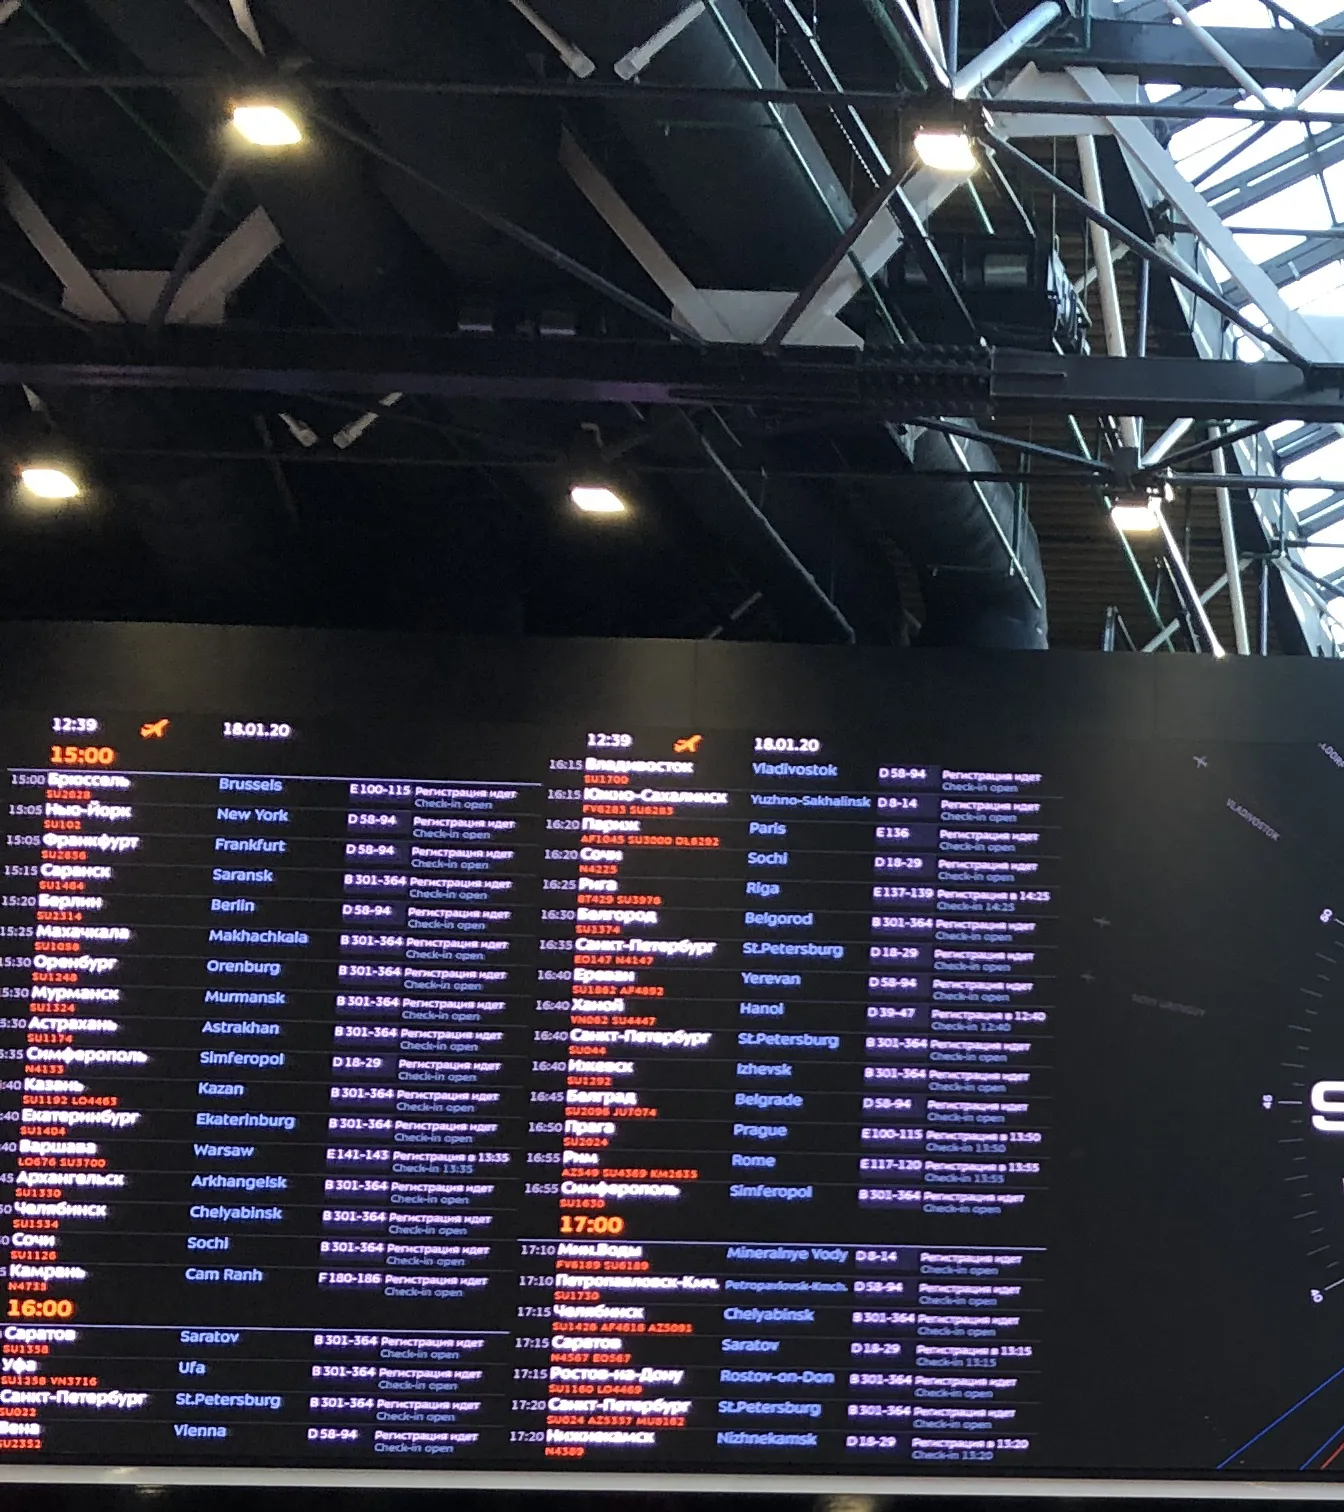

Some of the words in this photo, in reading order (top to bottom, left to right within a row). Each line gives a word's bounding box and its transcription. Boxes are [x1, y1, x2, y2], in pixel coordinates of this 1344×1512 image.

[52, 718, 97, 732] 12:39
[223, 722, 290, 737] 18.01.20
[587, 733, 632, 747] 12:39
[754, 738, 820, 752] 18.01.20
[50, 747, 113, 763] 15:00
[752, 762, 837, 777] Vladivostok
[47, 774, 130, 788] Брюссель
[219, 778, 282, 792] Brussels
[351, 784, 358, 795] E
[359, 785, 410, 796] 100-115
[751, 794, 870, 809] Yuzhno-Sakhalinsk
[217, 808, 248, 822] New
[251, 808, 289, 822] York
[348, 814, 356, 825] D
[359, 814, 397, 825] 58-94
[749, 821, 786, 835] Paris
[43, 833, 139, 851] Франкфурт
[215, 838, 286, 853] Frankfurt
[40, 864, 112, 878] Саранск
[212, 869, 273, 882] Saransk
[344, 875, 352, 885] B
[354, 875, 406, 887] 301-364
[746, 882, 780, 896] Riga
[211, 899, 255, 912] Berlin
[745, 912, 812, 927] Belgorod
[209, 930, 308, 944] Makhachkala
[206, 960, 280, 975] Orenburg
[741, 972, 800, 985] Yerevan
[205, 990, 285, 1004] Murmansk
[740, 1002, 784, 1015] Hanoi
[202, 1021, 279, 1034] Astrakhan
[200, 1052, 284, 1066] Simferopol
[198, 1082, 243, 1095] Kazan
[196, 1113, 295, 1129] Ekaterinburg
[733, 1123, 787, 1138] Prague
[194, 1144, 254, 1157] Warsaw
[732, 1154, 775, 1166] Rome
[191, 1175, 287, 1190] Arkhangelsk
[189, 1206, 282, 1221] Chelyabinsk
[560, 1216, 623, 1234] 17:00
[11, 1233, 56, 1247] Сочи
[187, 1236, 228, 1250] Sochi
[727, 1247, 809, 1262] Mineralnye
[813, 1248, 848, 1262] Vody
[185, 1268, 218, 1281] Cam
[223, 1268, 262, 1281] Ranh
[8, 1300, 72, 1317] 16:00
[180, 1330, 239, 1343] Saratov
[178, 1361, 205, 1375] Ufa
[720, 1370, 835, 1384] Rostov-on-Don
[176, 1392, 281, 1408] St.Petersburg
[174, 1424, 226, 1437] Vienna
